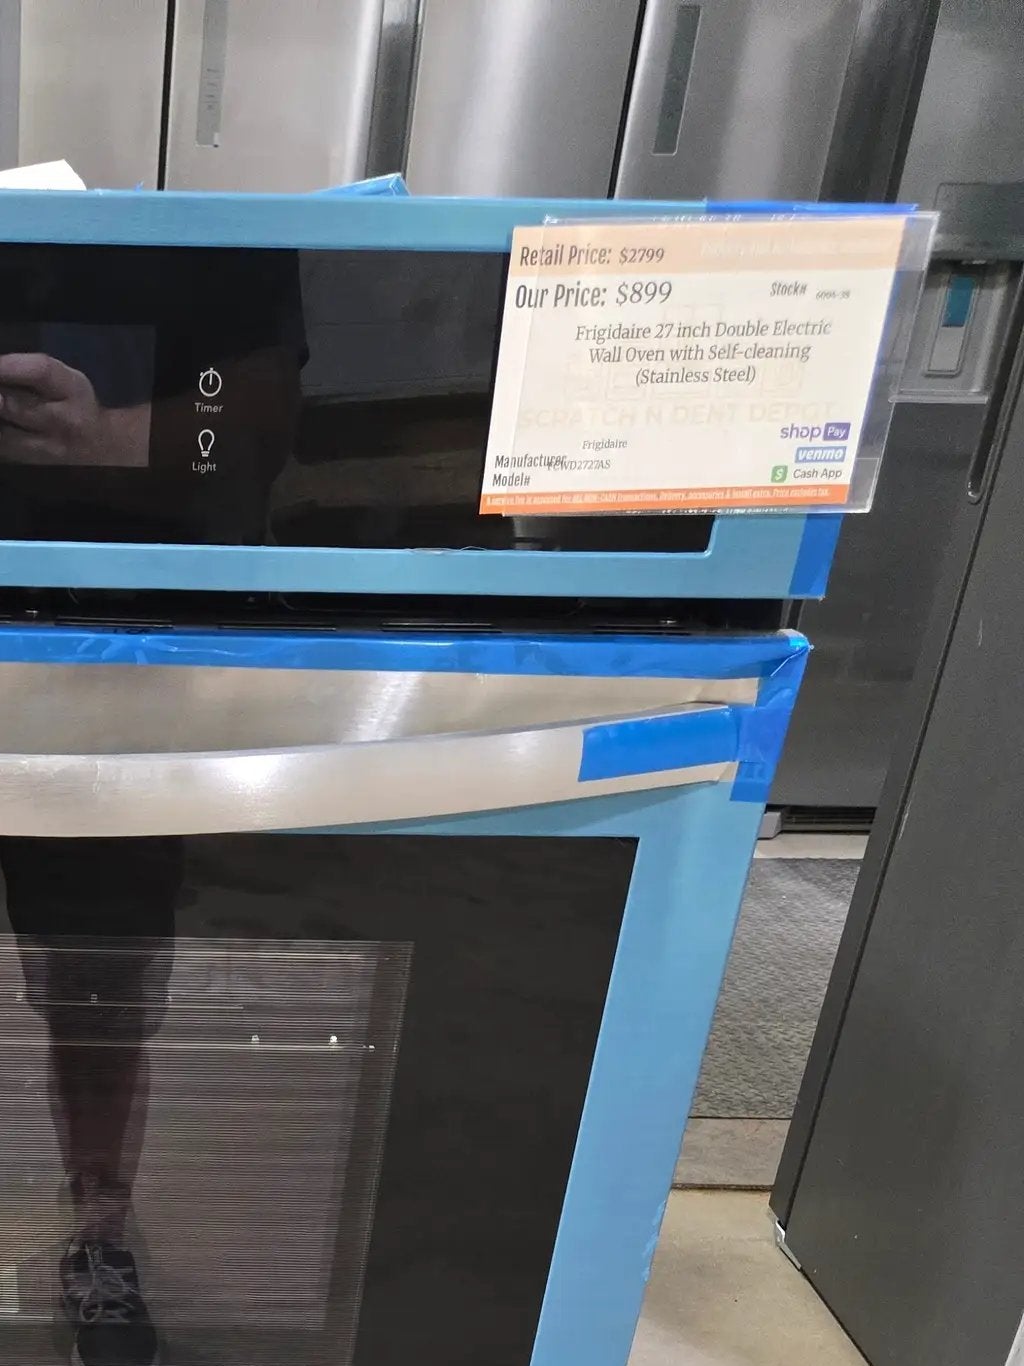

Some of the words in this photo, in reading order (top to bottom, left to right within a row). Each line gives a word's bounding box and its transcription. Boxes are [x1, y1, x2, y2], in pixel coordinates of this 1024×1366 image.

[520, 244, 565, 266] Retail
[567, 243, 612, 266] Price:
[619, 246, 665, 266] $2799
[515, 284, 549, 309] Our
[553, 281, 608, 309] Price:
[616, 280, 673, 306] $899
[769, 280, 808, 298] Stock#
[575, 323, 651, 345] Frigidaire
[654, 323, 674, 339] 27
[676, 321, 711, 338] inch
[714, 319, 769, 337] Double
[772, 319, 832, 336] Electric
[589, 346, 622, 363] Wall
[625, 347, 665, 362] Oven
[669, 344, 704, 361] with
[708, 342, 812, 363] Self-cleaning
[635, 367, 709, 387] (Stainless
[713, 365, 756, 385] Steel)
[194, 402, 224, 413] Timer
[780, 423, 821, 442] shop
[826, 425, 847, 438] Pay
[582, 438, 628, 451] Frigidaire
[797, 447, 843, 461] venmo
[192, 461, 217, 473] Light
[793, 469, 818, 479] Cash
[820, 468, 843, 479] App
[492, 472, 531, 487] Model#
